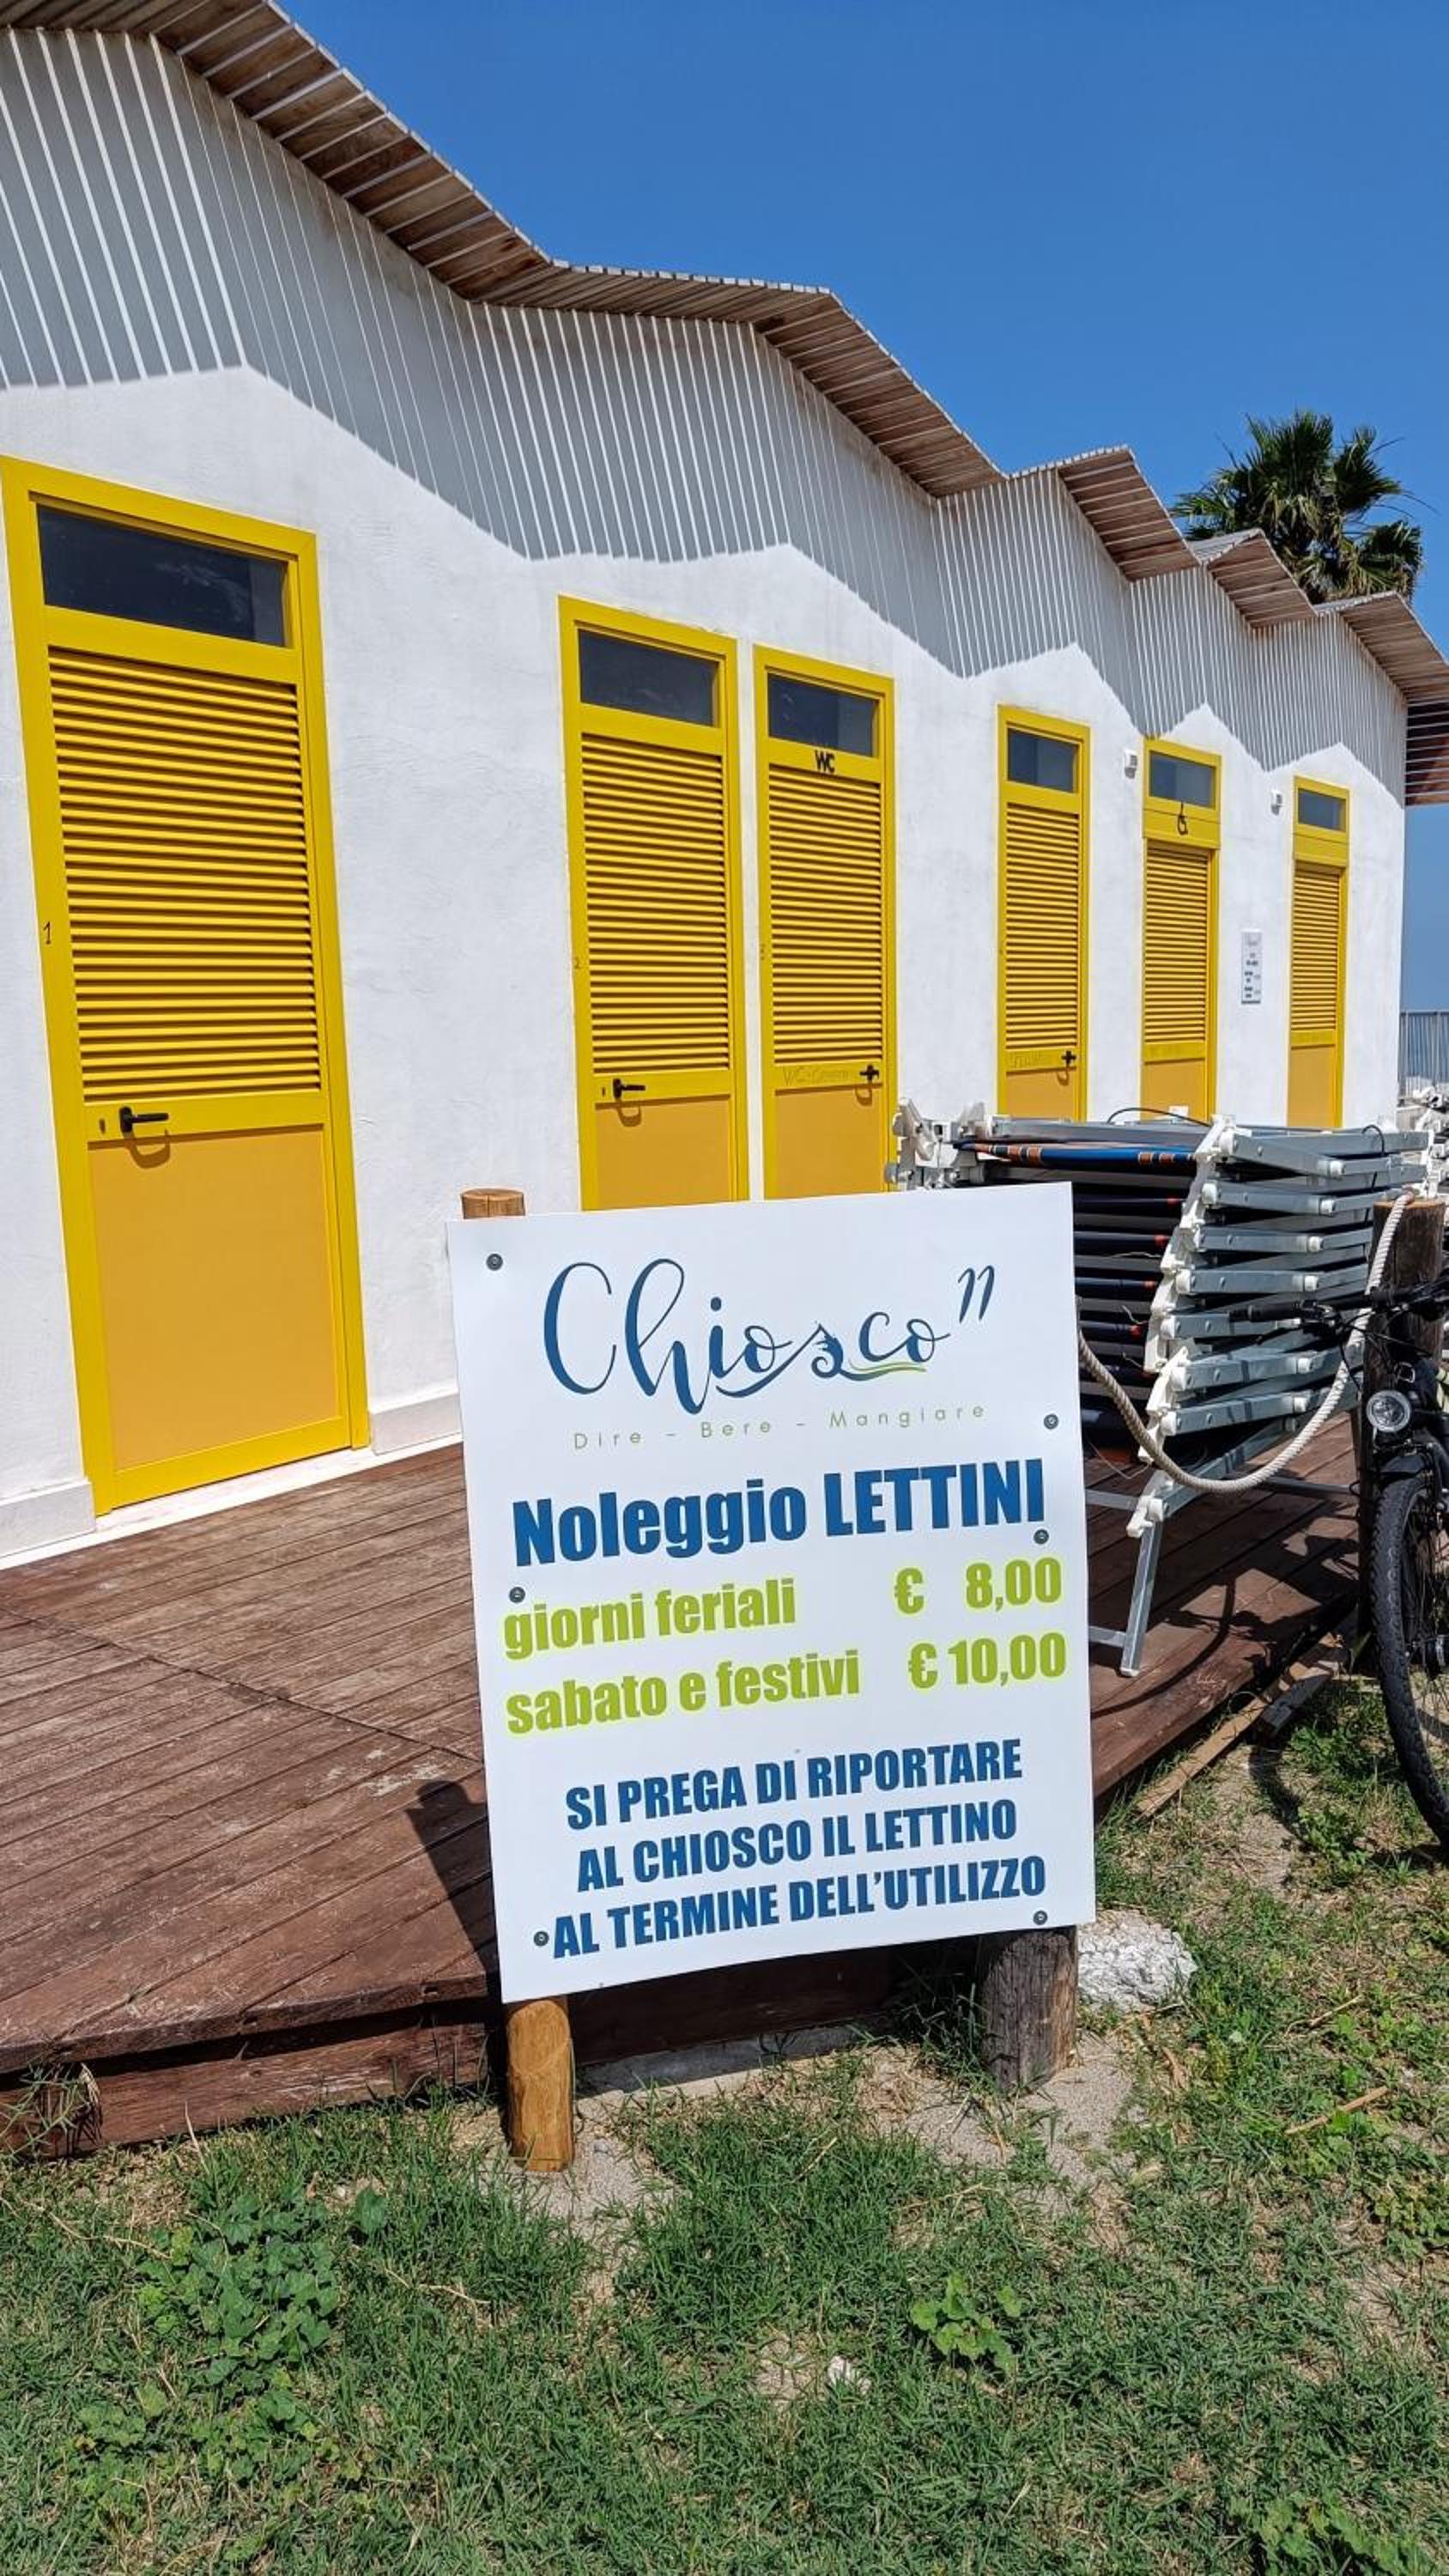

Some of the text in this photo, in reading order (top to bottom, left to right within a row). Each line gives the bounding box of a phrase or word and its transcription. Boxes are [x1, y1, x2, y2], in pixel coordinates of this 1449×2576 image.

[815, 749, 835, 773] WC
[43, 921, 52, 945] 1
[544, 1259, 950, 1415] Chiosco
[573, 1430, 642, 1449] Dire
[700, 1419, 772, 1438] Bere
[829, 1404, 985, 1428] Mangiare
[512, 1459, 1045, 1566] Noleggio LETTINI
[505, 1558, 1061, 1659] giorni feriali € 8,00
[507, 1633, 1065, 1733] sabato e festivi € 10,00
[566, 1739, 1023, 1830] SI PREGA DI RIPORTARE
[578, 1800, 1017, 1893] AL CHIOSCO IL LETTINO
[554, 1912, 600, 1959] AL
[607, 1887, 780, 1948] TERMINE
